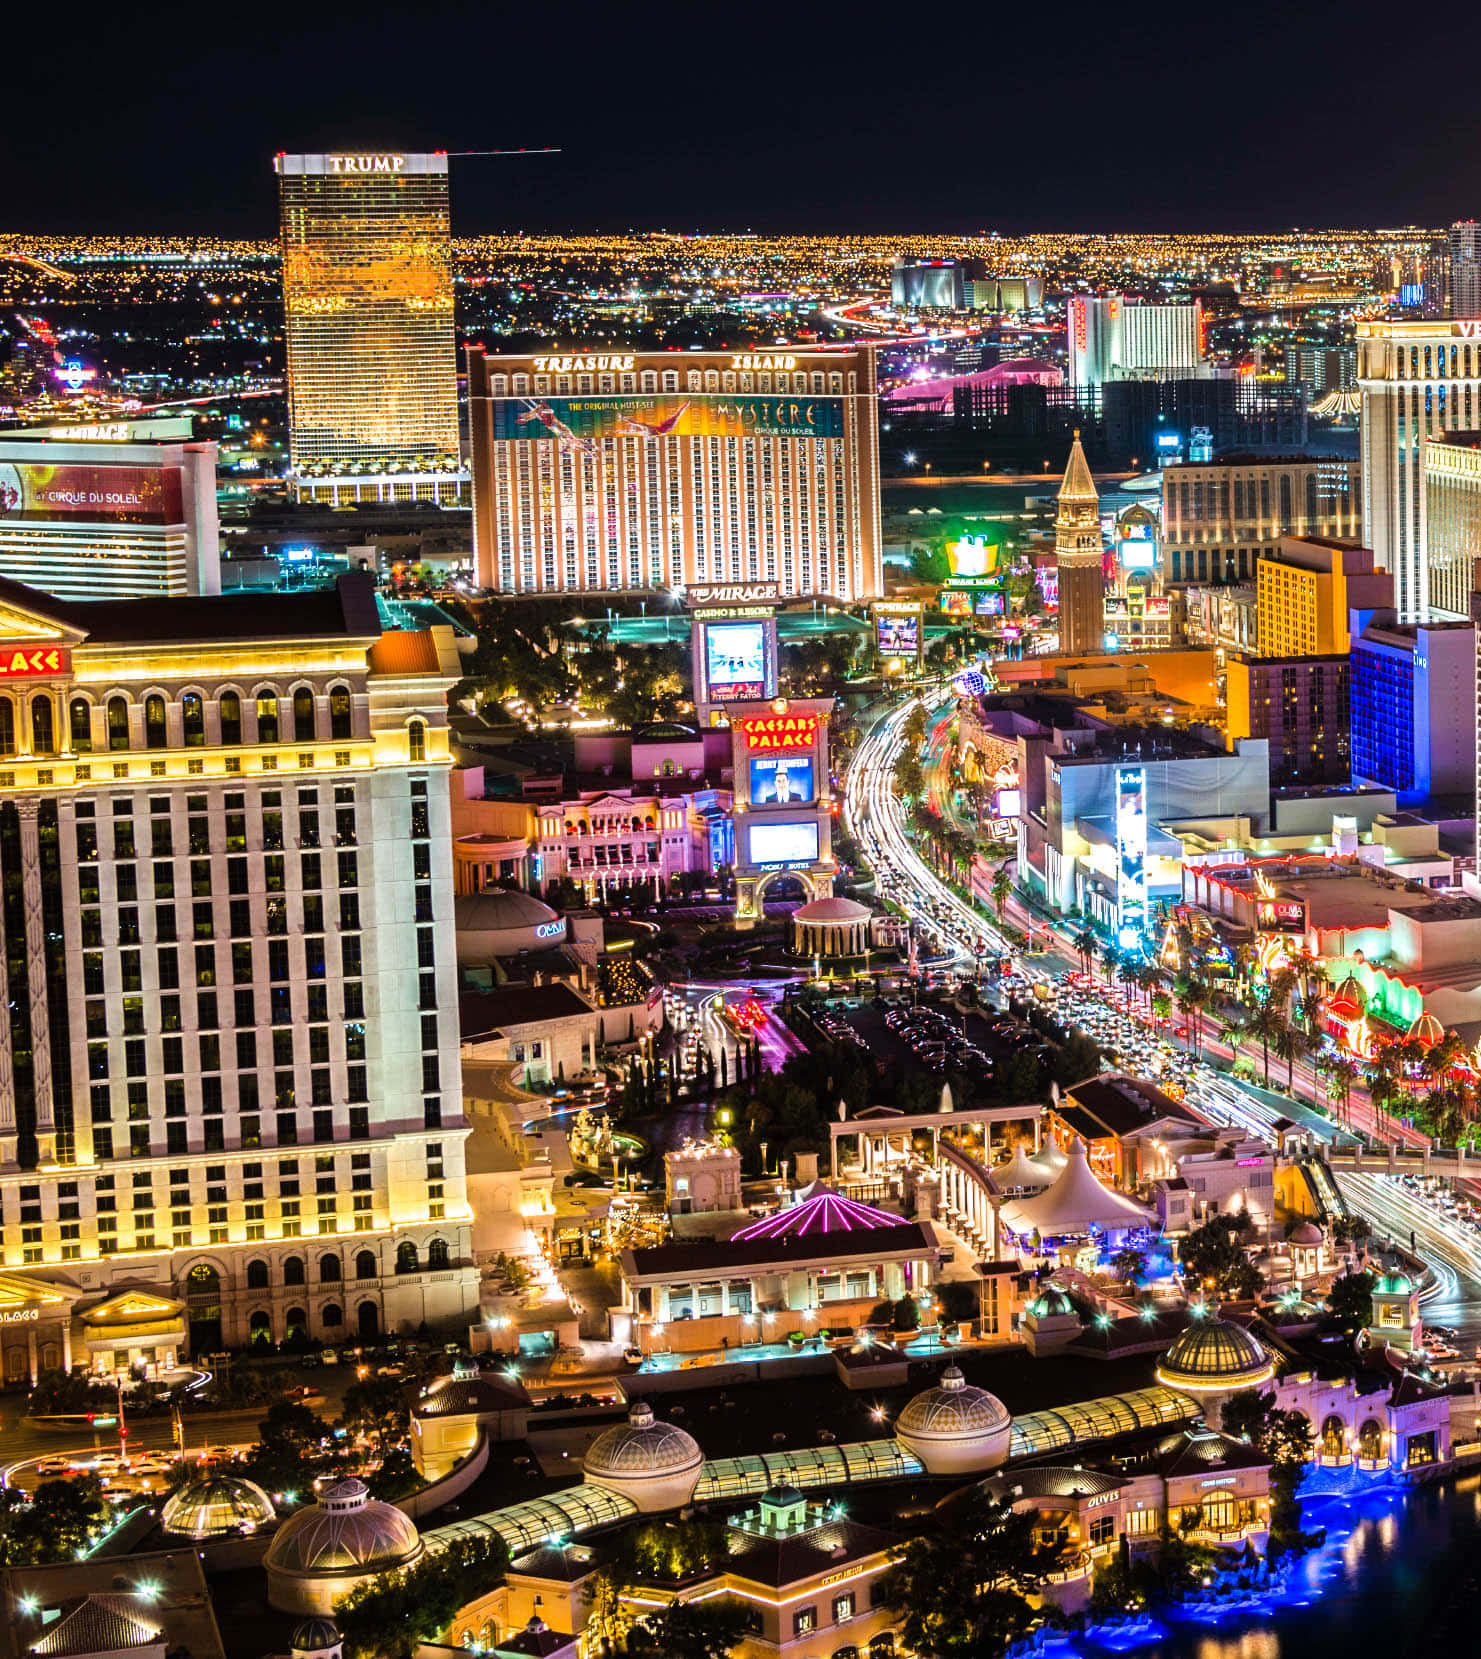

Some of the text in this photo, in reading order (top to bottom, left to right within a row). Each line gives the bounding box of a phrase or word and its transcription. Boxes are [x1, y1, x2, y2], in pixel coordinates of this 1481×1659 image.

[329, 156, 405, 172] TRUMP
[534, 354, 796, 372] TREASURE ISLAND
[568, 401, 655, 411] THE ORIGINAL MUST-SEE
[754, 427, 815, 435] CIRQUE DU SOLEIL
[48, 491, 86, 505] CIRQUE
[89, 493, 104, 503] DU
[106, 493, 141, 504] SOLEIL
[698, 585, 777, 602] MIRAGE
[694, 607, 727, 618] CASINO
[738, 606, 775, 616] RESORT
[745, 717, 816, 733] CAESARS
[750, 733, 812, 747] PALACE
[760, 863, 783, 872] NOBU
[1088, 1490, 1120, 1508] OLIVES
